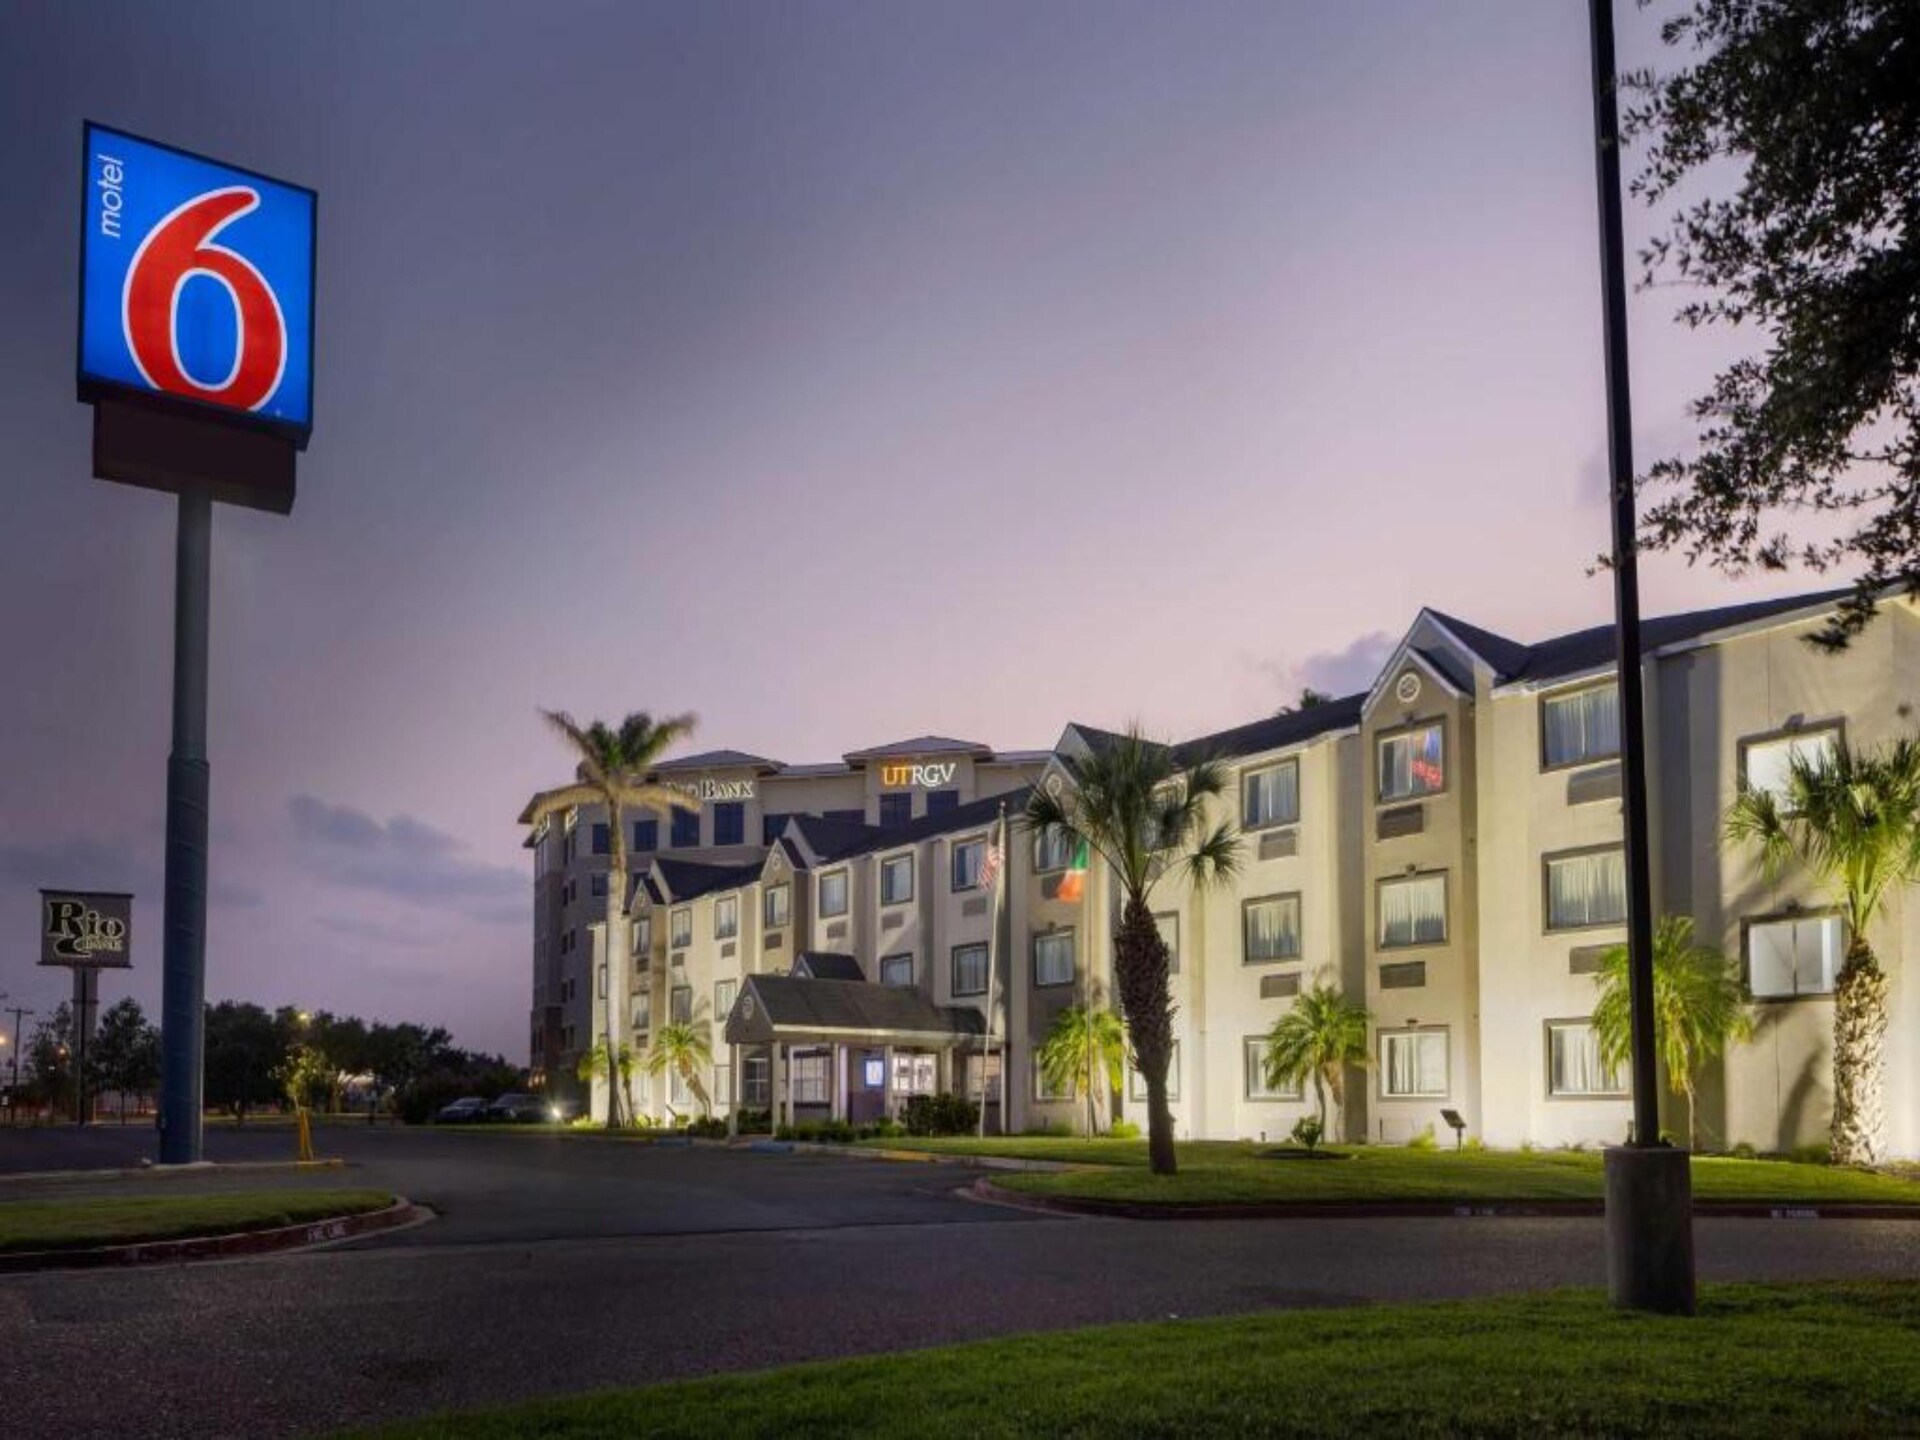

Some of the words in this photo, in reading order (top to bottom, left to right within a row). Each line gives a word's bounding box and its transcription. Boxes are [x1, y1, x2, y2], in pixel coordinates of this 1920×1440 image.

[97, 154, 124, 239] motel
[121, 185, 287, 412] 6
[882, 763, 957, 787] UTRGV
[47, 900, 126, 958] Rio
